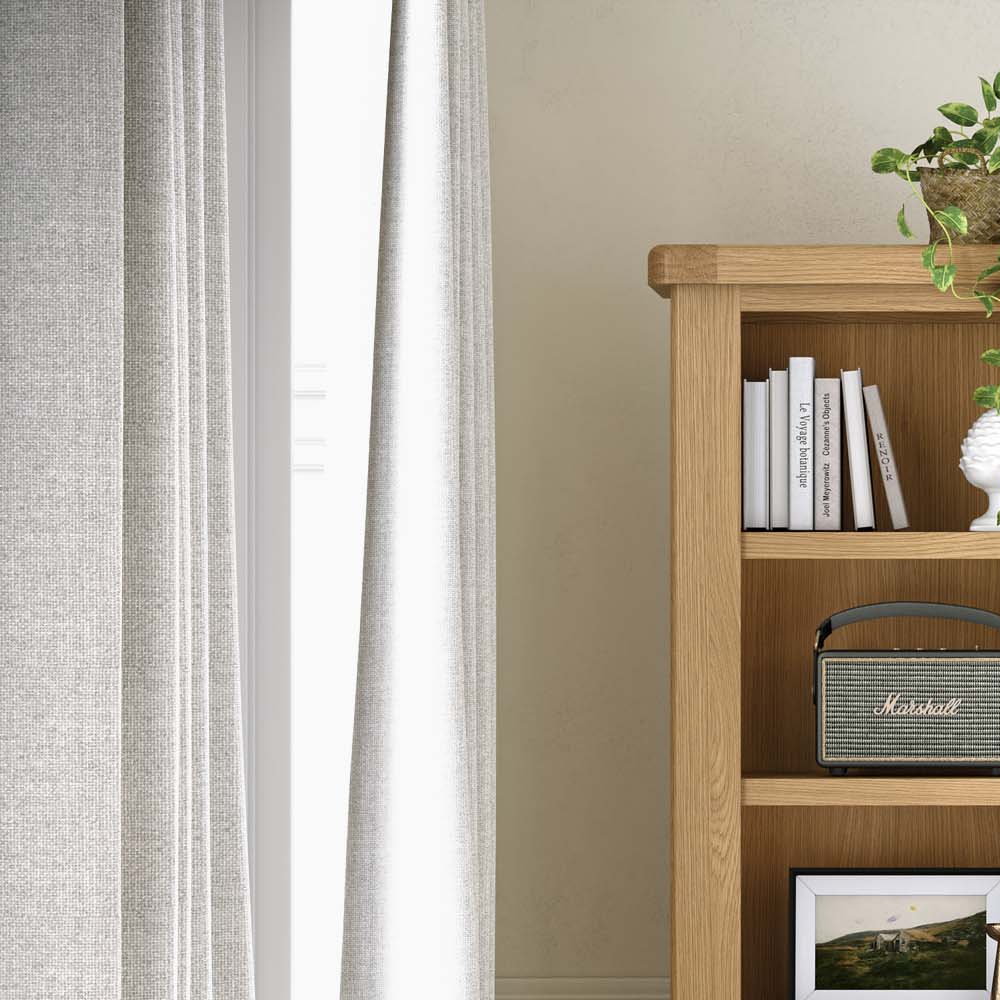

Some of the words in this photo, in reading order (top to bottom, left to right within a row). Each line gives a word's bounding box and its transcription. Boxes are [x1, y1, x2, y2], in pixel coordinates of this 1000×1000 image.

[799, 402, 810, 413] Le
[822, 393, 832, 420] Objects
[795, 415, 810, 446] Voyage
[795, 447, 811, 489] botanique
[876, 432, 893, 481] RENOIR
[822, 463, 832, 501] Meyerowitz
[822, 502, 830, 517] Joel
[873, 692, 962, 715] Marshall
